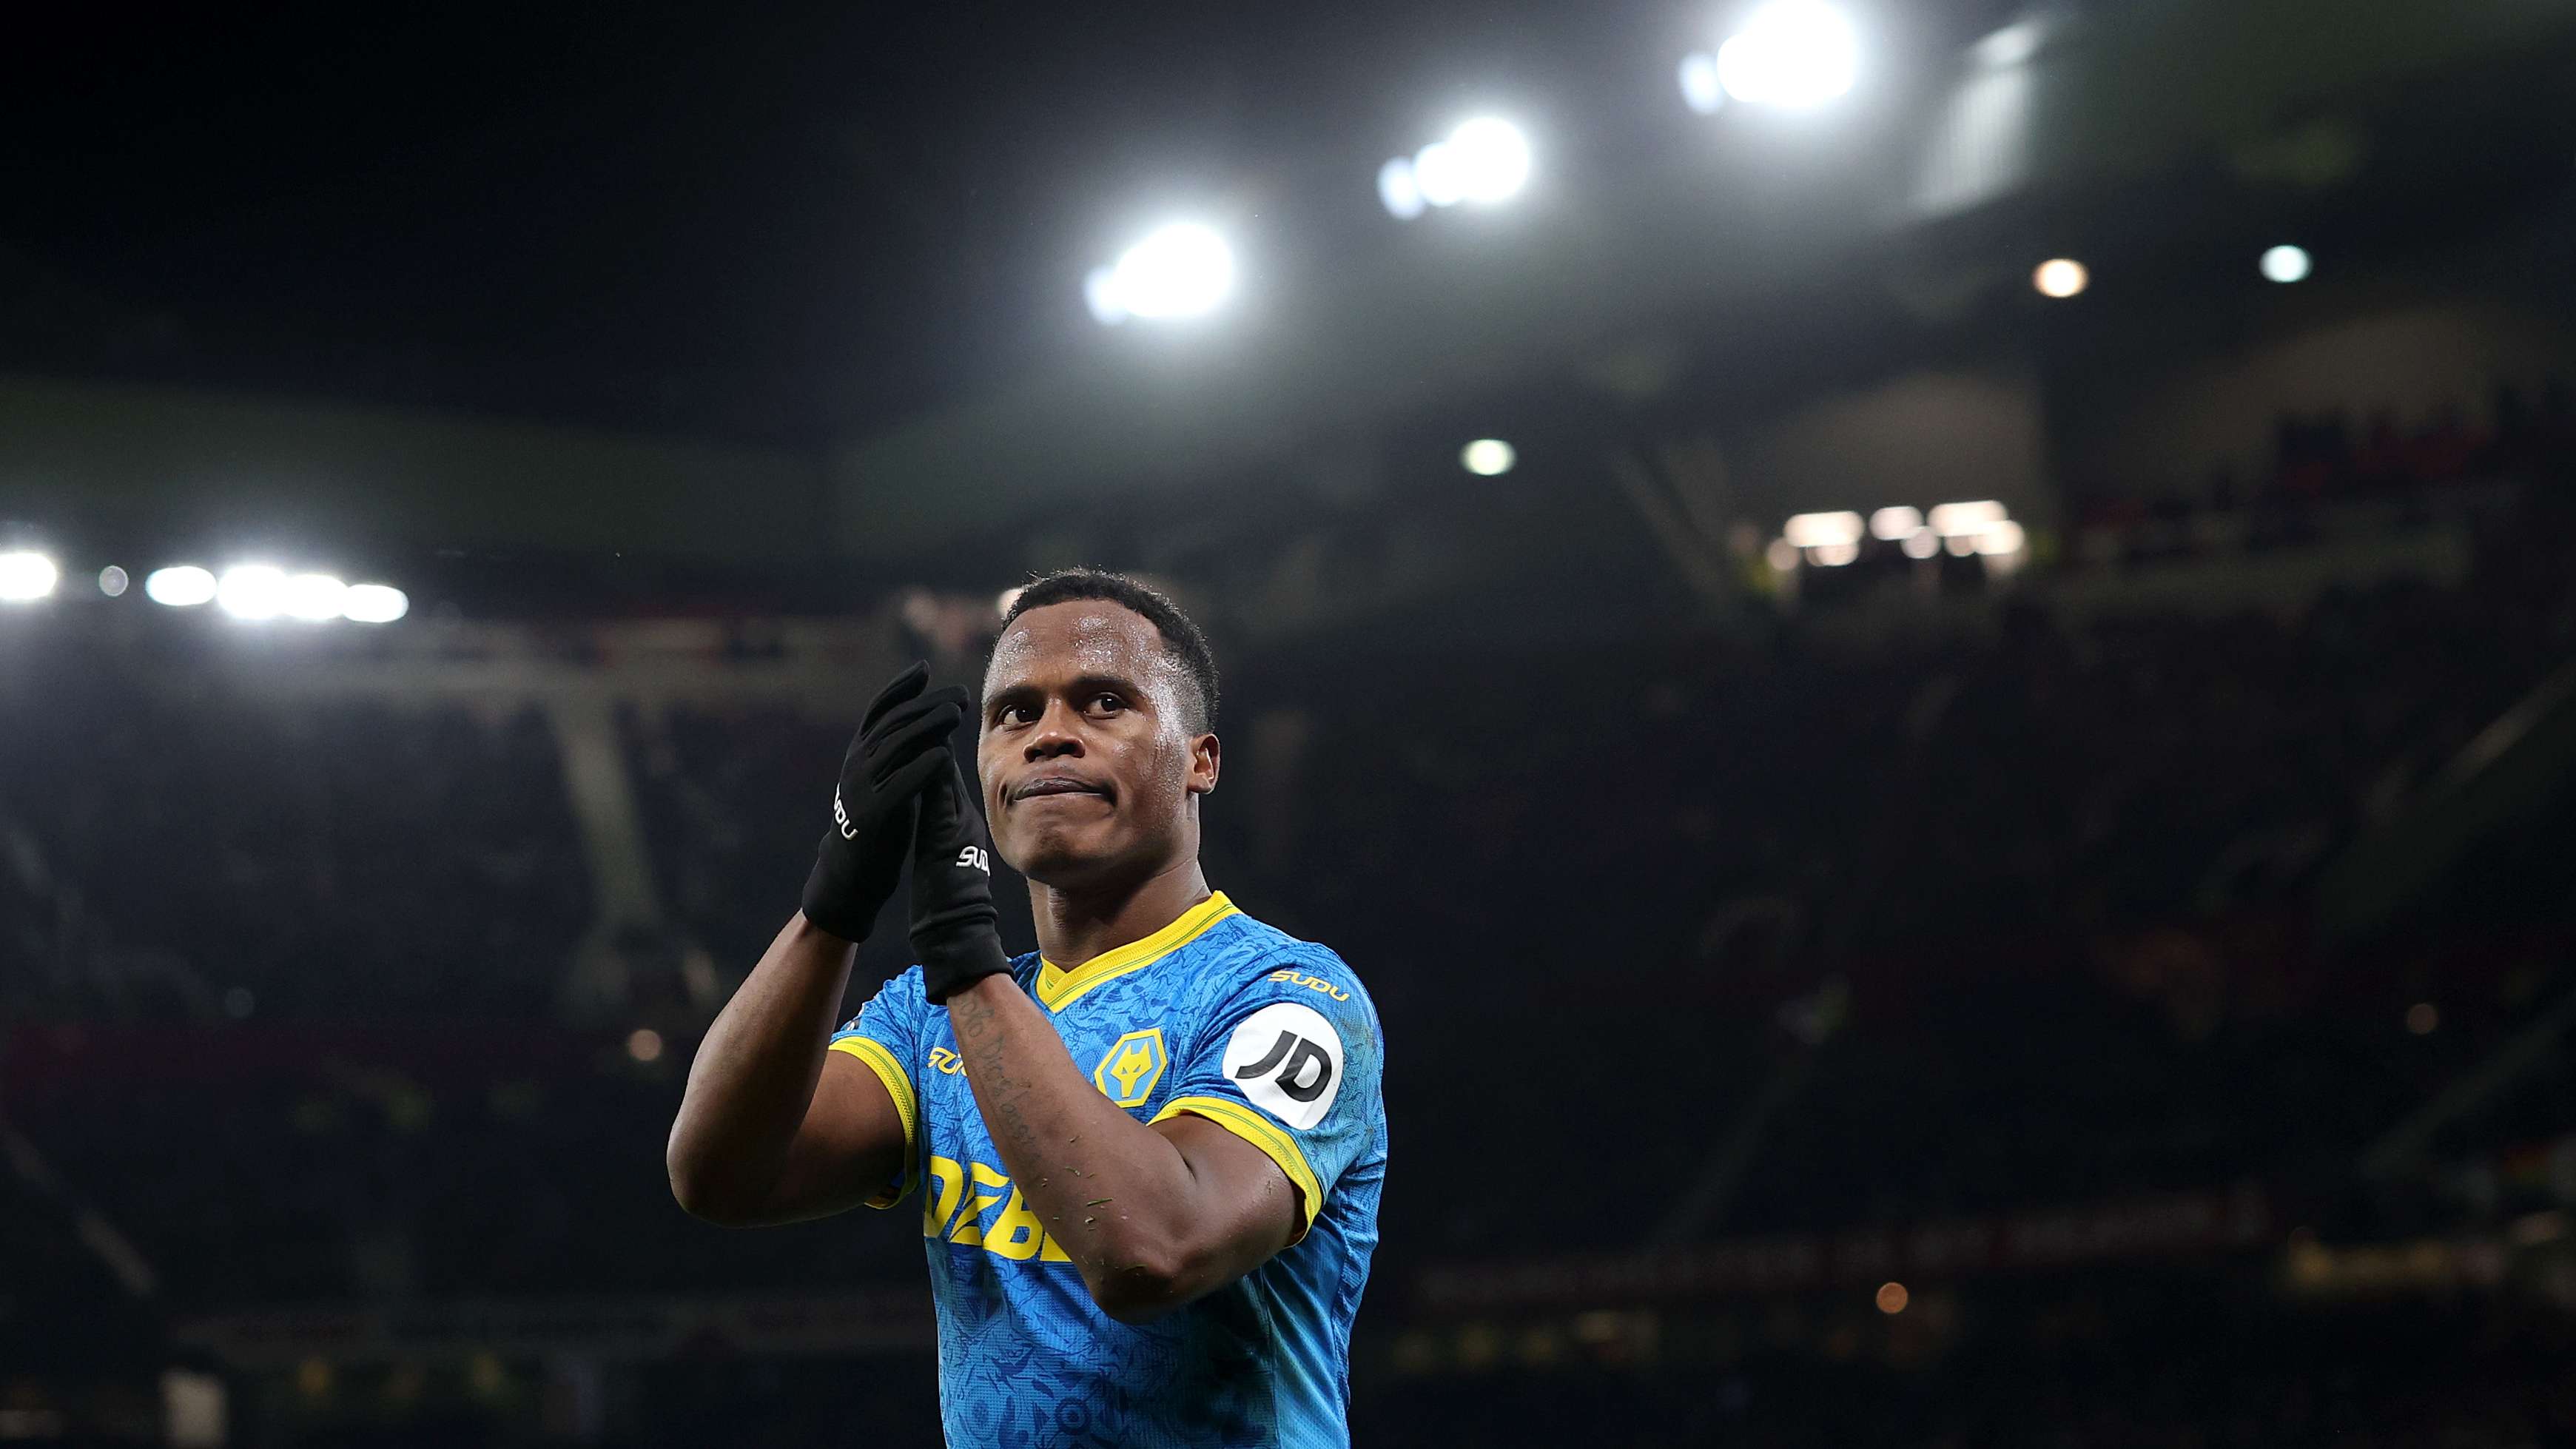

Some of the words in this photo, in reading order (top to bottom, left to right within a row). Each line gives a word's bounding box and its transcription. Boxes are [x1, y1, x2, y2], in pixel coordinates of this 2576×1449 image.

[955, 846, 990, 876] SUD
[1267, 970, 1351, 1001] SUDU
[1234, 1029, 1332, 1103] JD
[924, 1155, 1072, 1263] DEB
